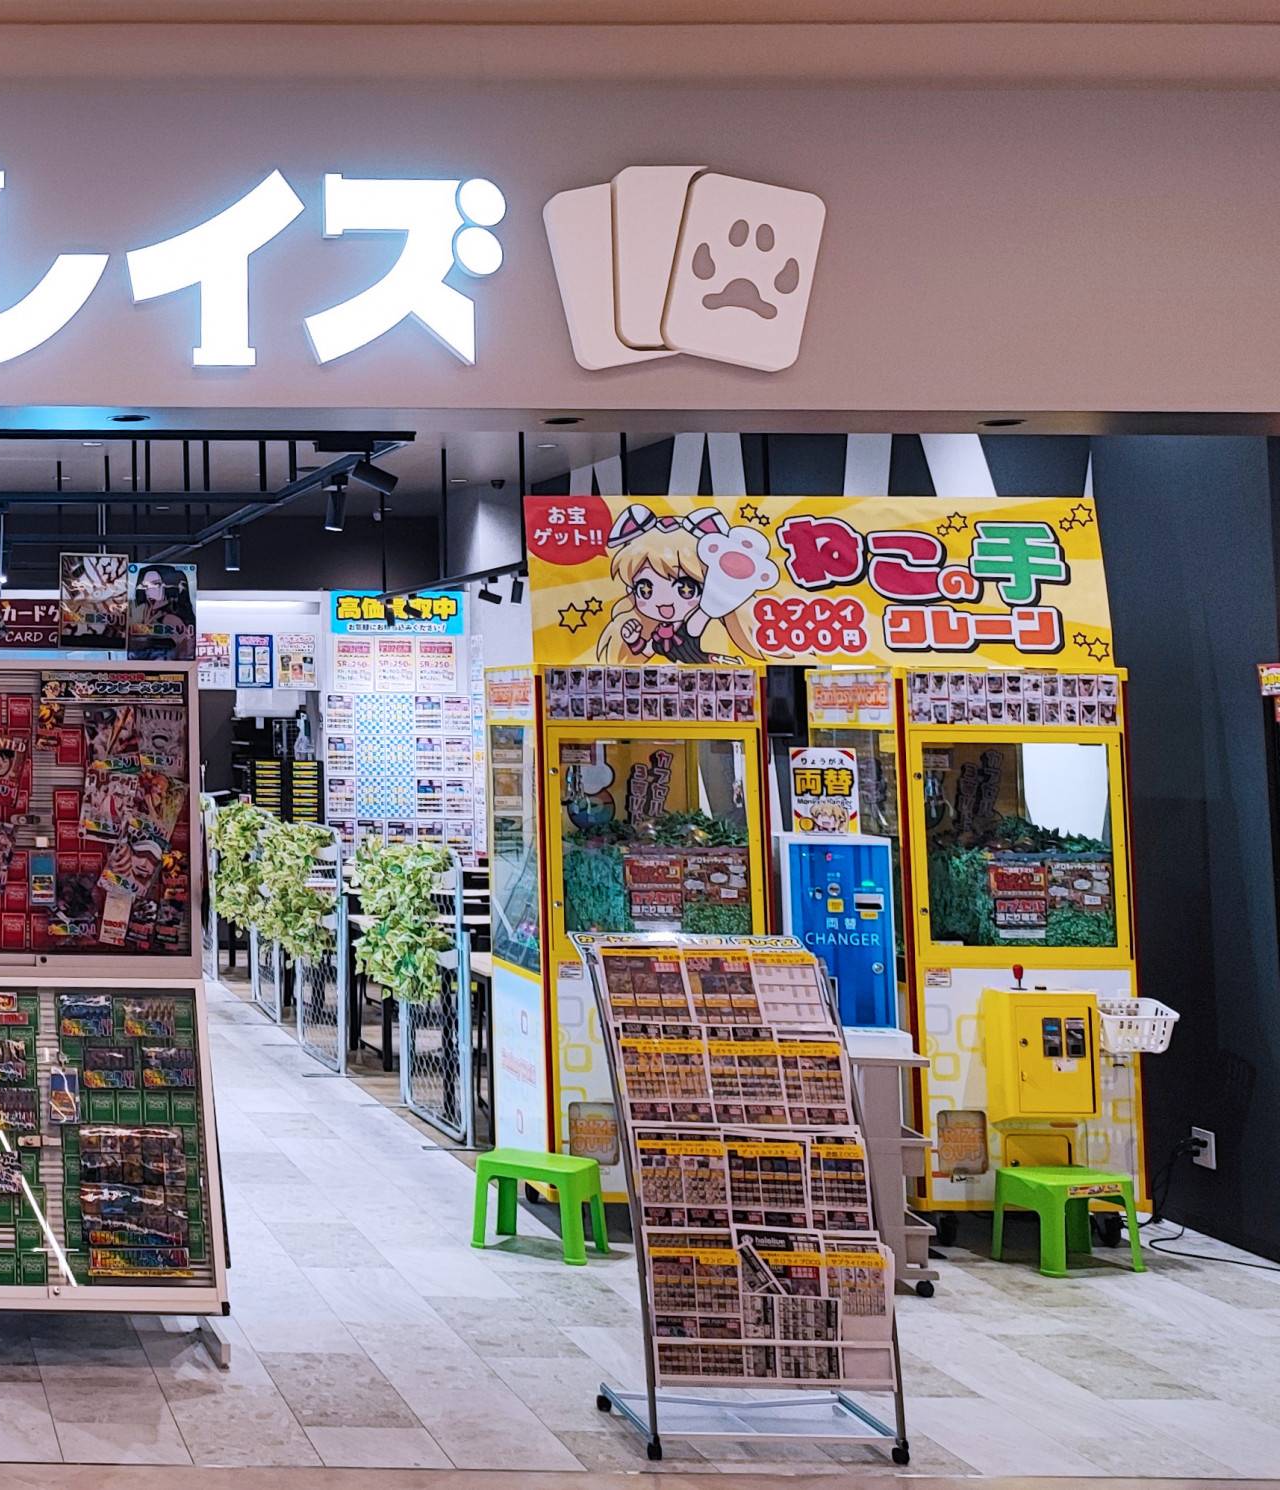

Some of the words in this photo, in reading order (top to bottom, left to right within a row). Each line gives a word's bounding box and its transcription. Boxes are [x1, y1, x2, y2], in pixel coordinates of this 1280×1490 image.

[548, 506, 587, 525] お宝
[534, 528, 603, 546] ゲット!!
[777, 515, 1070, 606] ねこの手
[762, 604, 853, 621] 1プレイ
[5, 631, 43, 643] CARD
[882, 604, 1065, 653] クレーン
[764, 629, 860, 646] 100円
[801, 757, 845, 766] りょうがえ
[793, 767, 854, 797] 両替
[805, 932, 880, 946] CHANGER
